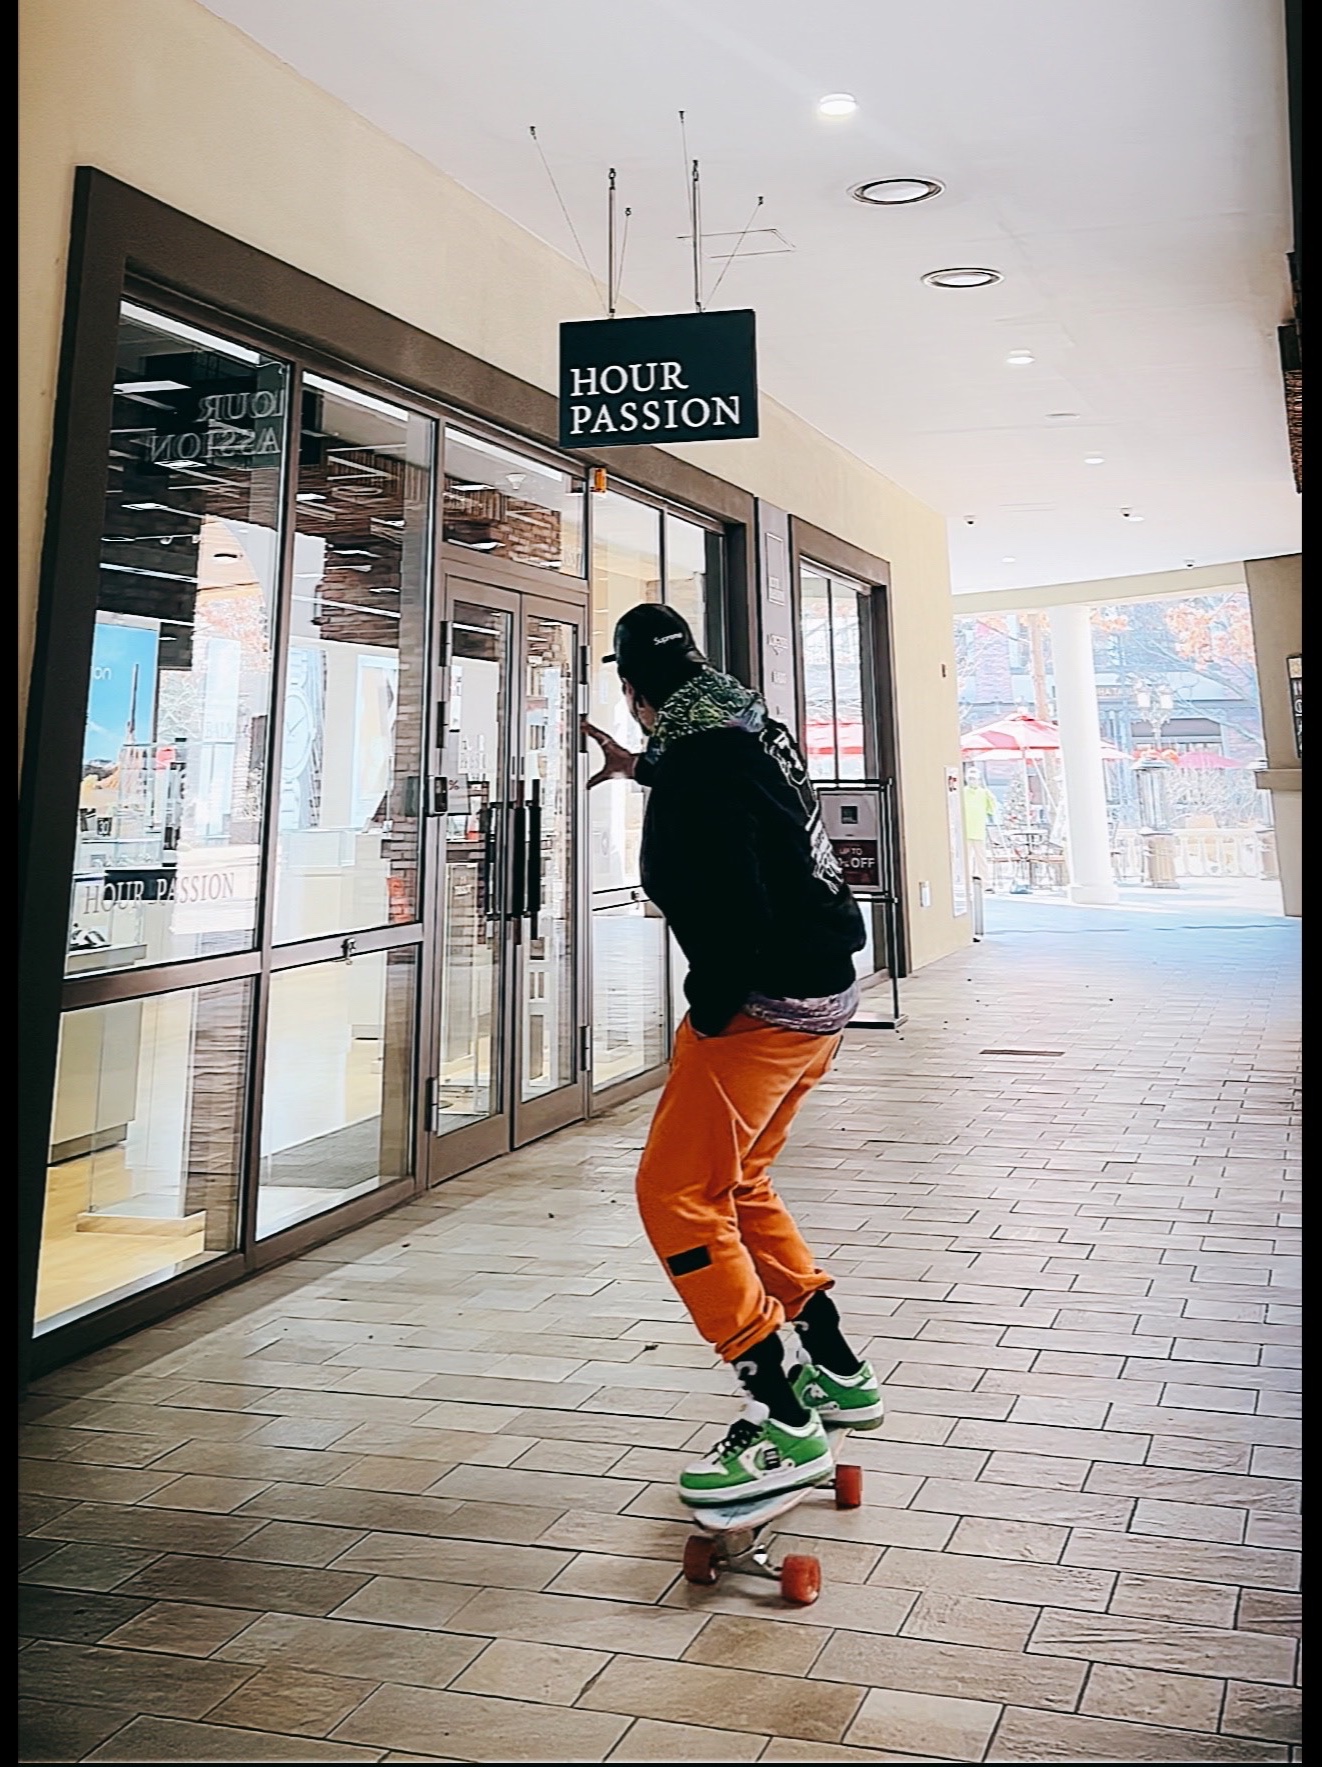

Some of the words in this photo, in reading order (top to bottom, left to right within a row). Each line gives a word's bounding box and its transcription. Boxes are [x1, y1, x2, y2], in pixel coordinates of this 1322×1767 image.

[570, 362, 689, 396] HOUR
[570, 396, 740, 434] PASSION
[83, 880, 146, 914] HOUR
[156, 873, 235, 906] PASSION
